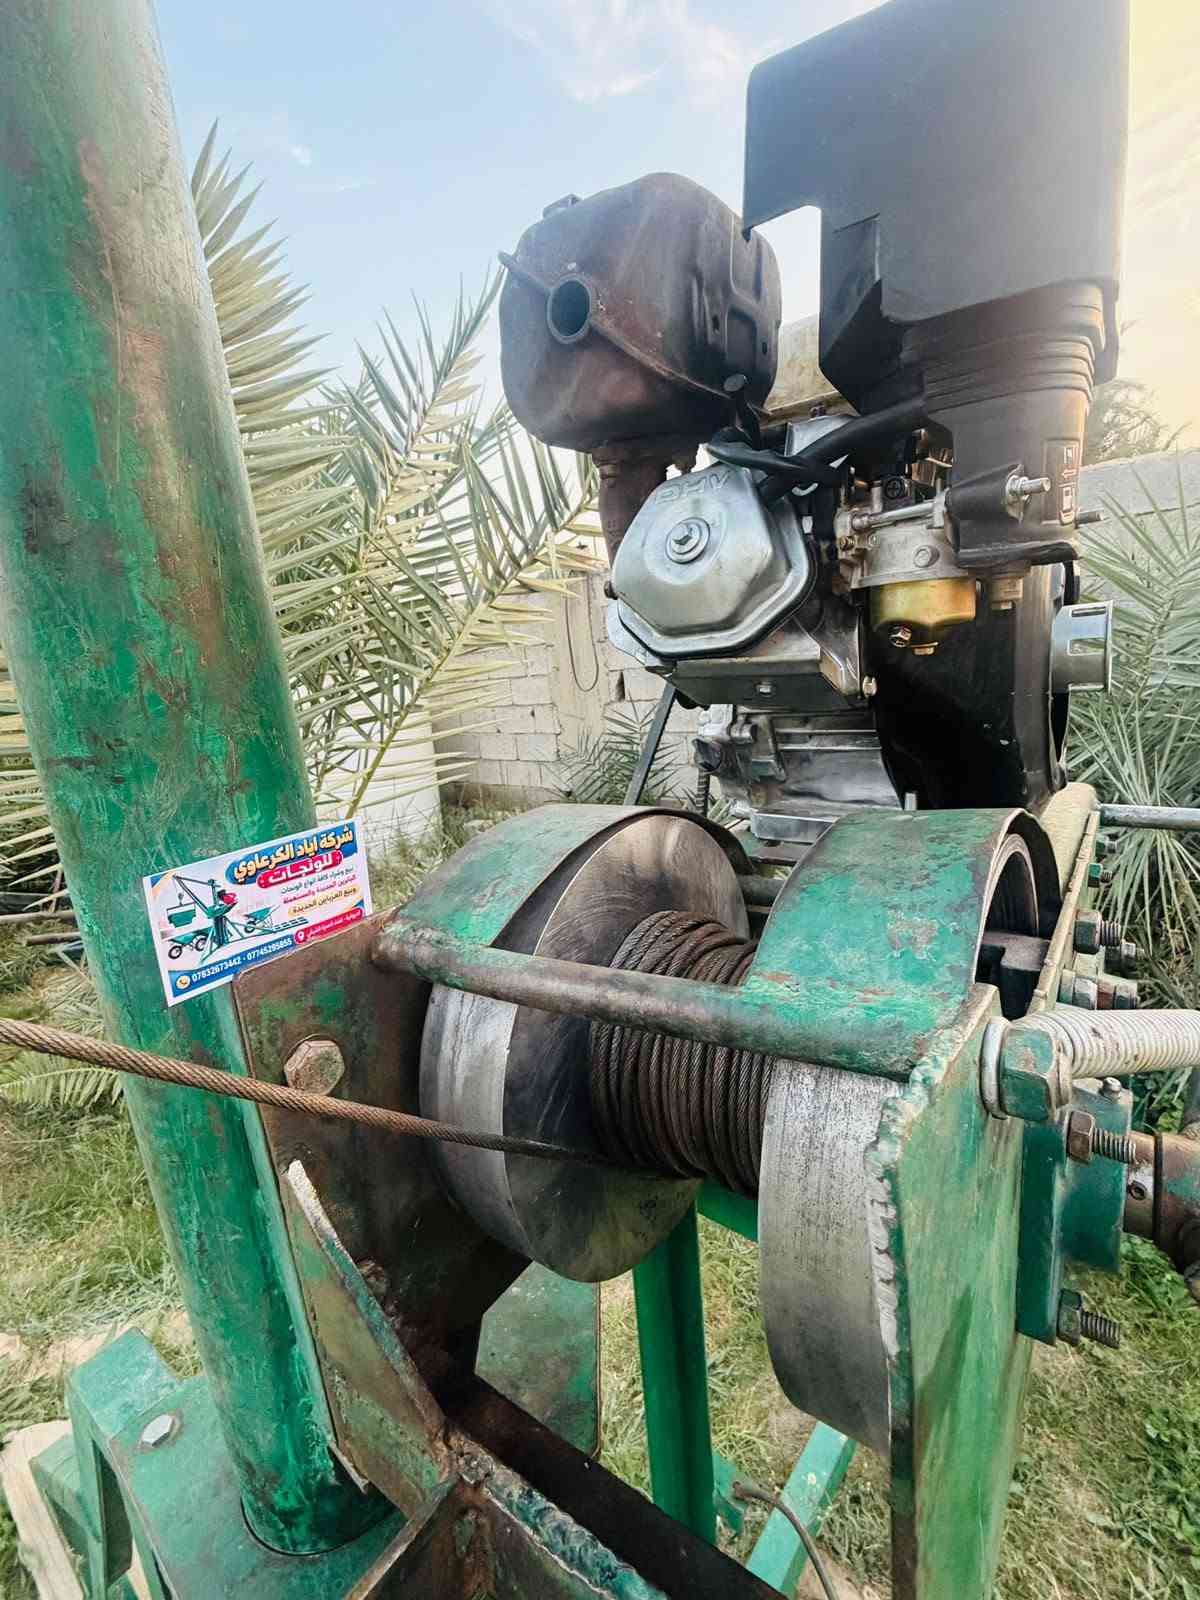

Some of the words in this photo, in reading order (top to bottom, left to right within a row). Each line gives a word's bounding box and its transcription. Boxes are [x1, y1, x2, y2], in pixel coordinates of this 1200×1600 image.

[319, 824, 353, 850] شركة
[234, 843, 295, 882] الكرعاوي
[268, 853, 333, 883] للونجات
